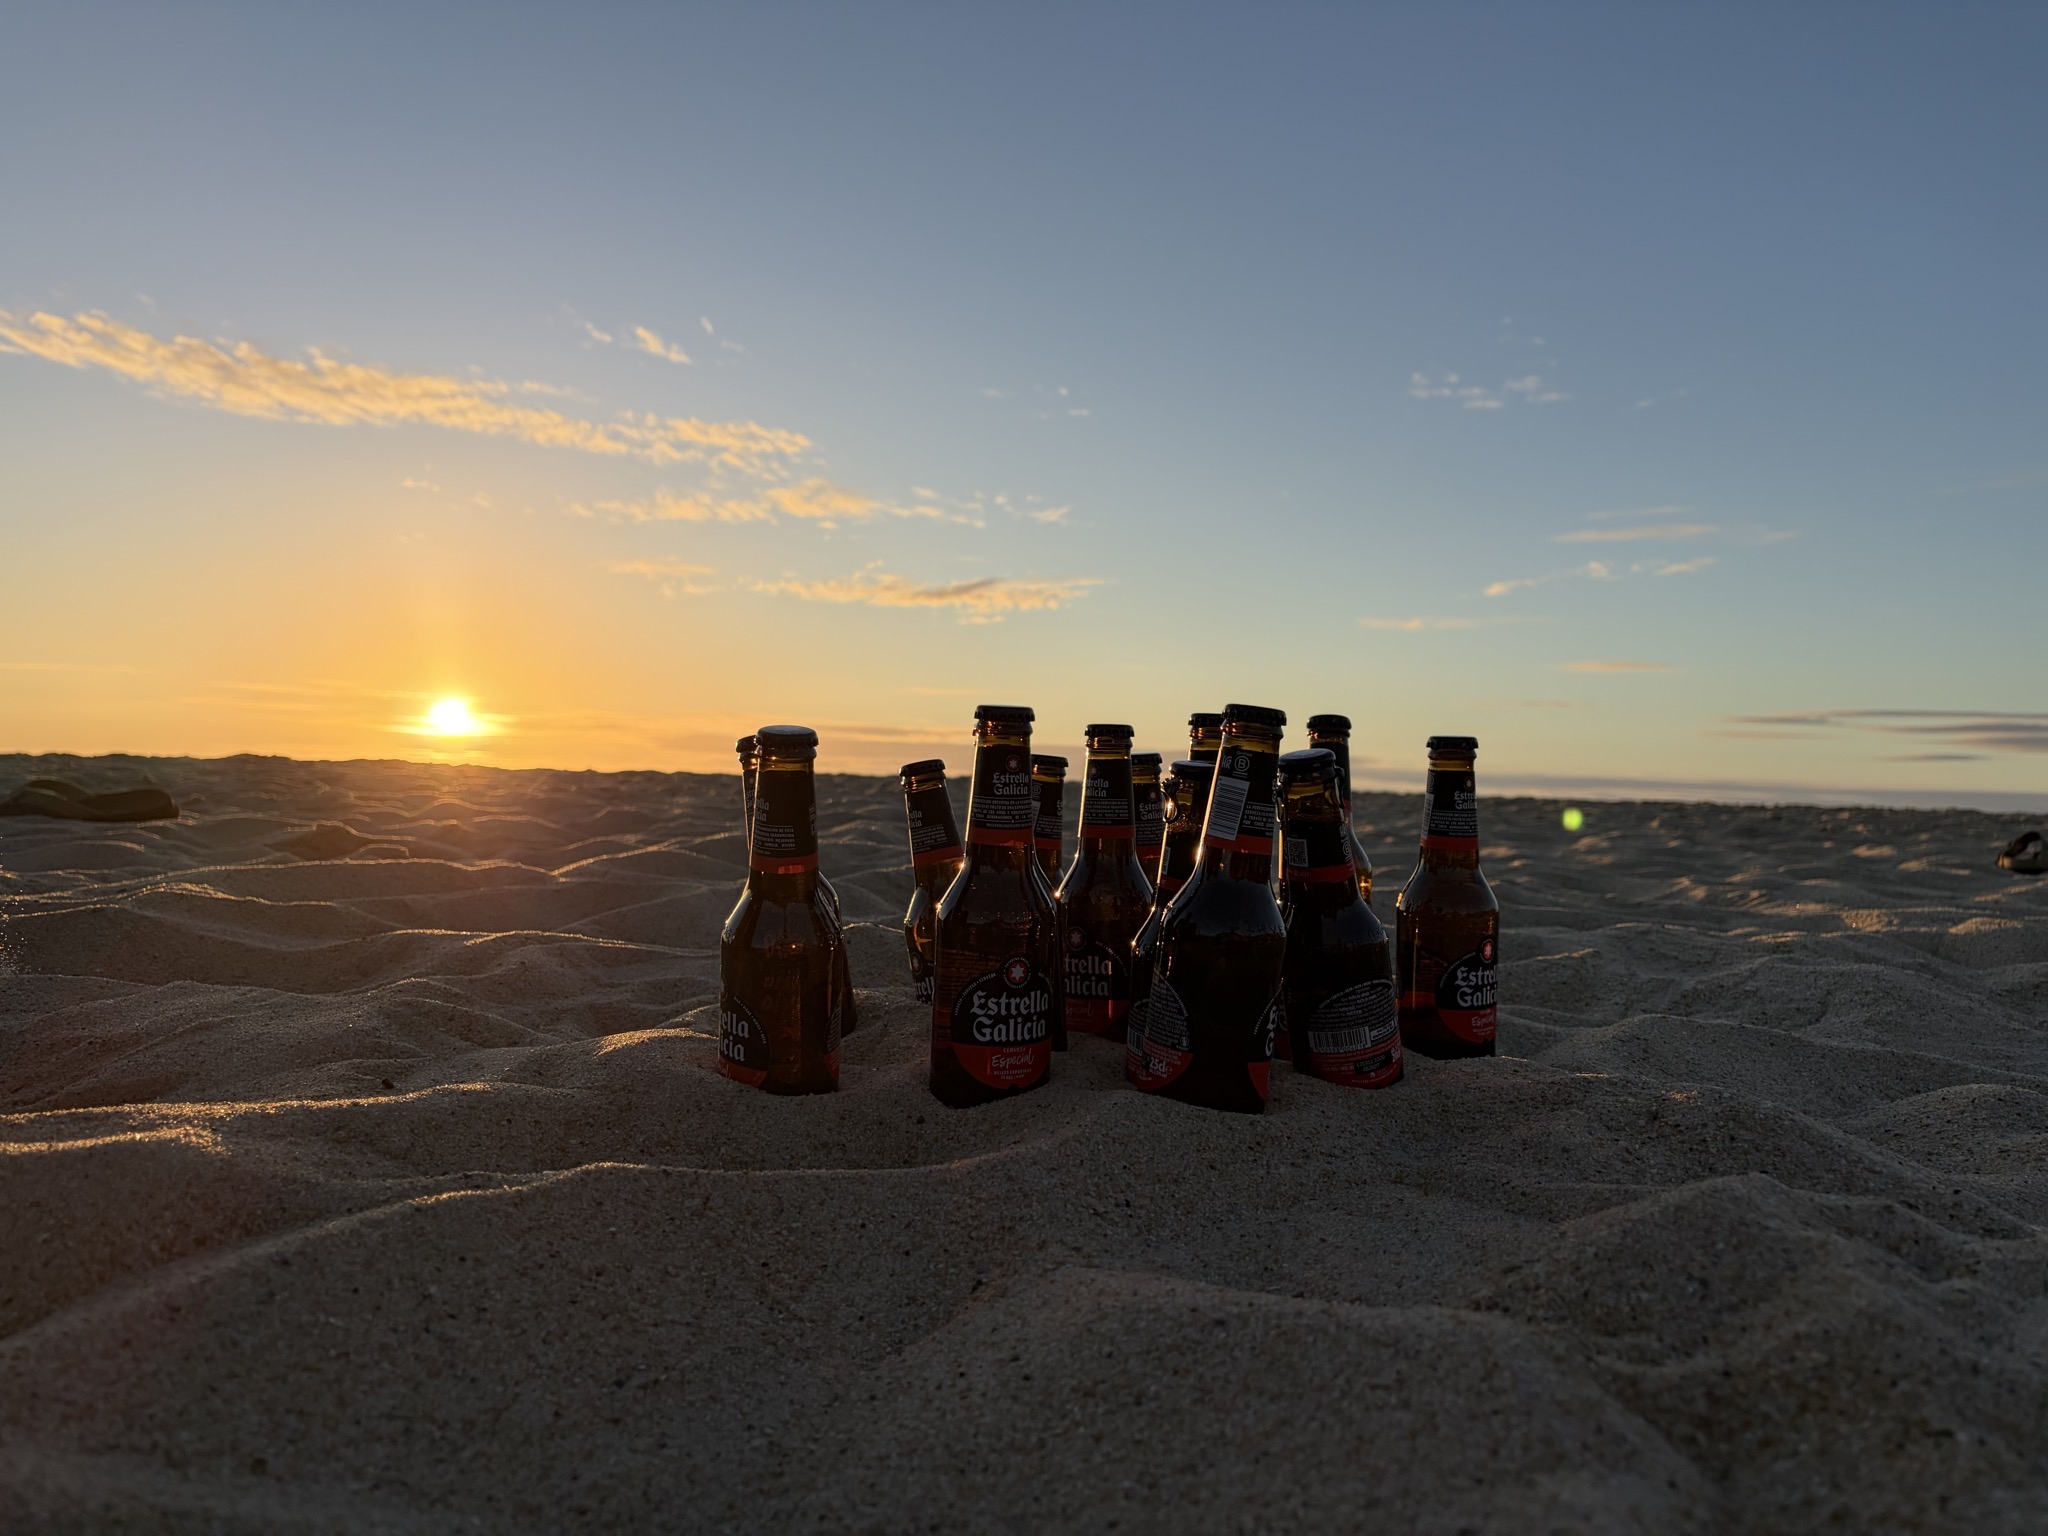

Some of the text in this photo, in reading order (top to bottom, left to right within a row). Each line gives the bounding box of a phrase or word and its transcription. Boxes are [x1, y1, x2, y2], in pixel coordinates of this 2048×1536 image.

[993, 772, 1029, 784] Estrella
[994, 784, 1028, 795] Galicia
[970, 989, 1049, 1017] Estrella
[972, 1014, 1047, 1042] Galicia
[991, 1047, 1035, 1069] Especial
